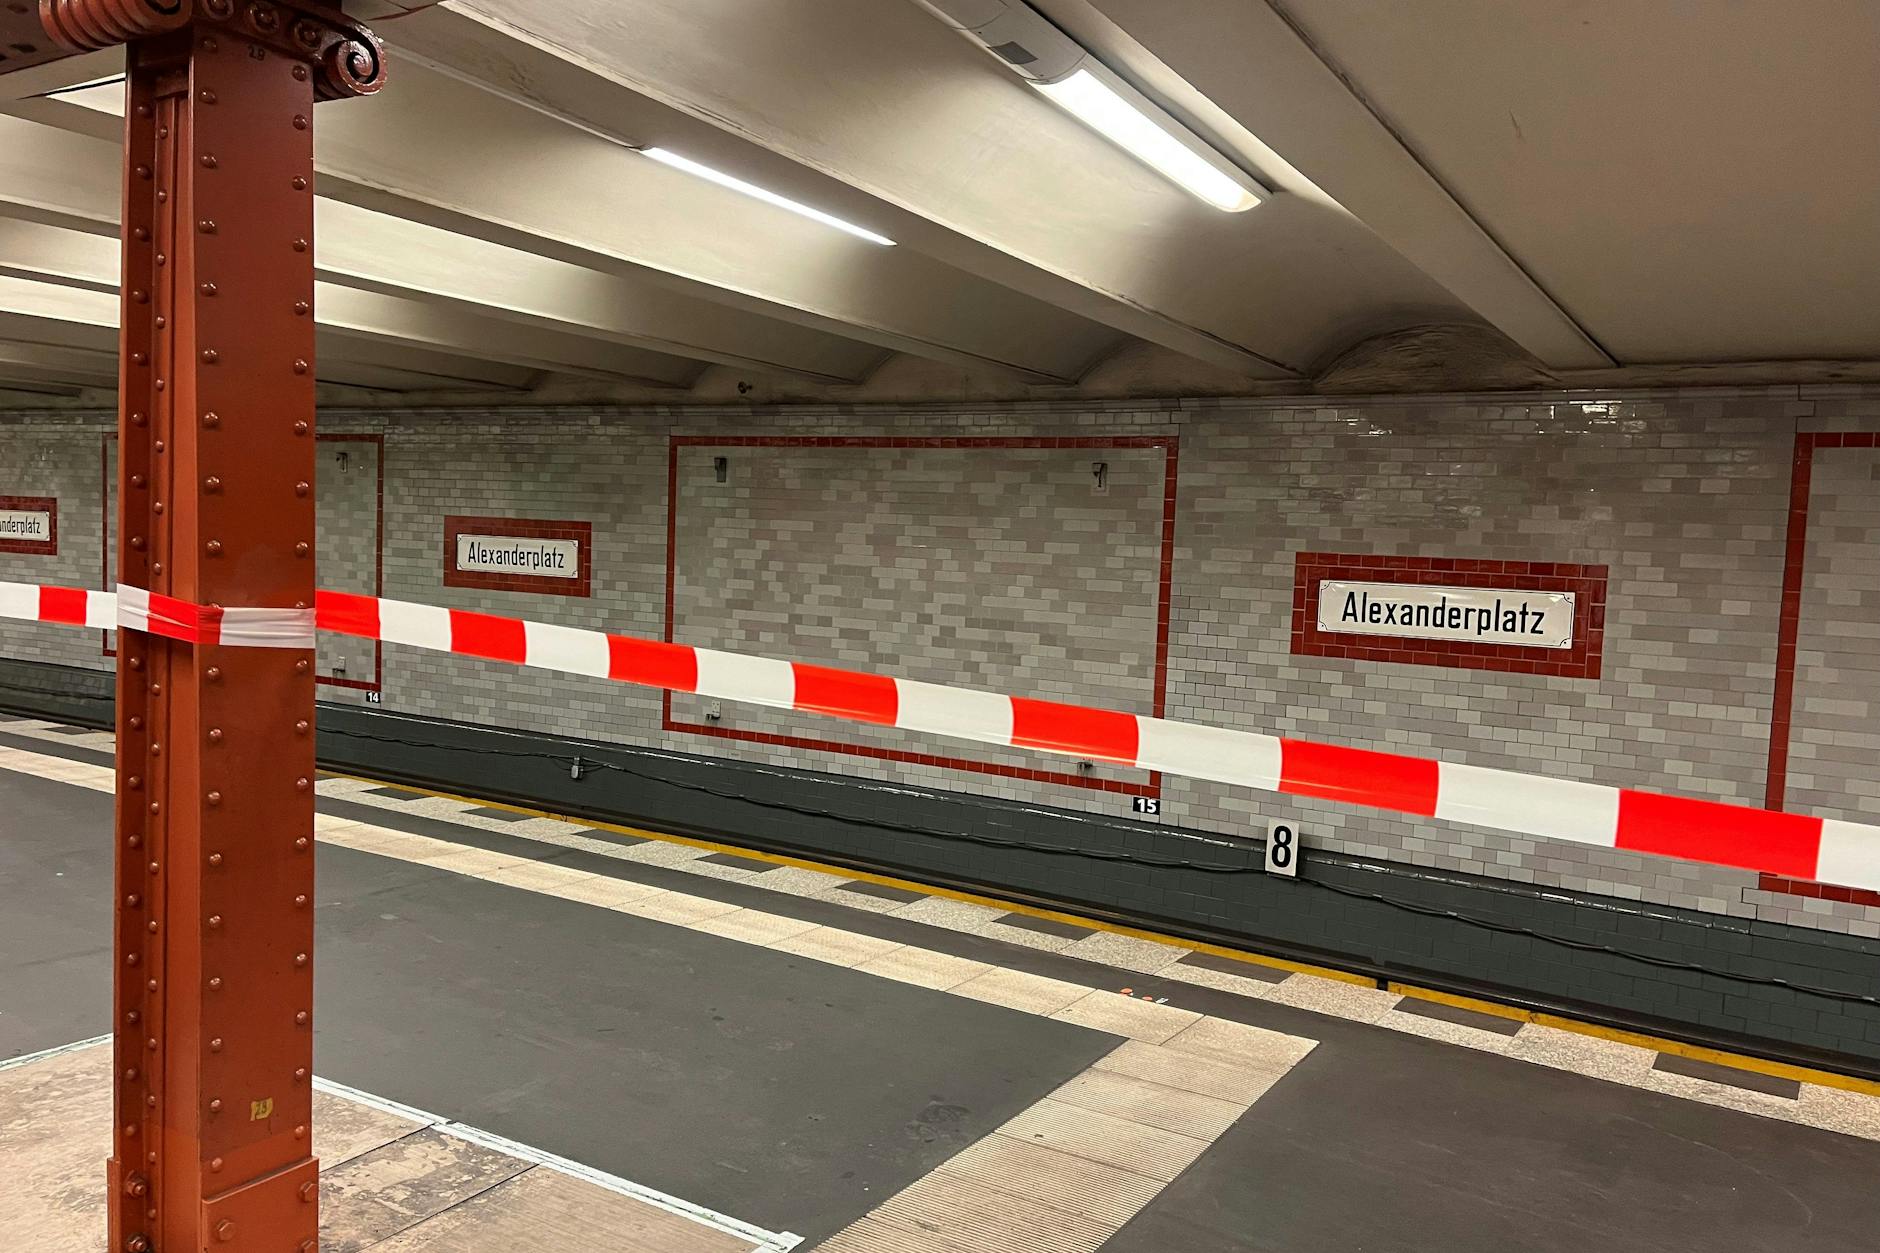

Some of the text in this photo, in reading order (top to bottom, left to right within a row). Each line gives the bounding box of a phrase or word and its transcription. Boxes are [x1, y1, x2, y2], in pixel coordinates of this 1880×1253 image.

[0, 515, 41, 536] nderplatz
[468, 541, 564, 570] Alexanderplatz
[1341, 591, 1545, 635] Alexanderplatz
[367, 692, 379, 703] 14
[1137, 798, 1157, 813] 15
[1271, 825, 1292, 868] 8
